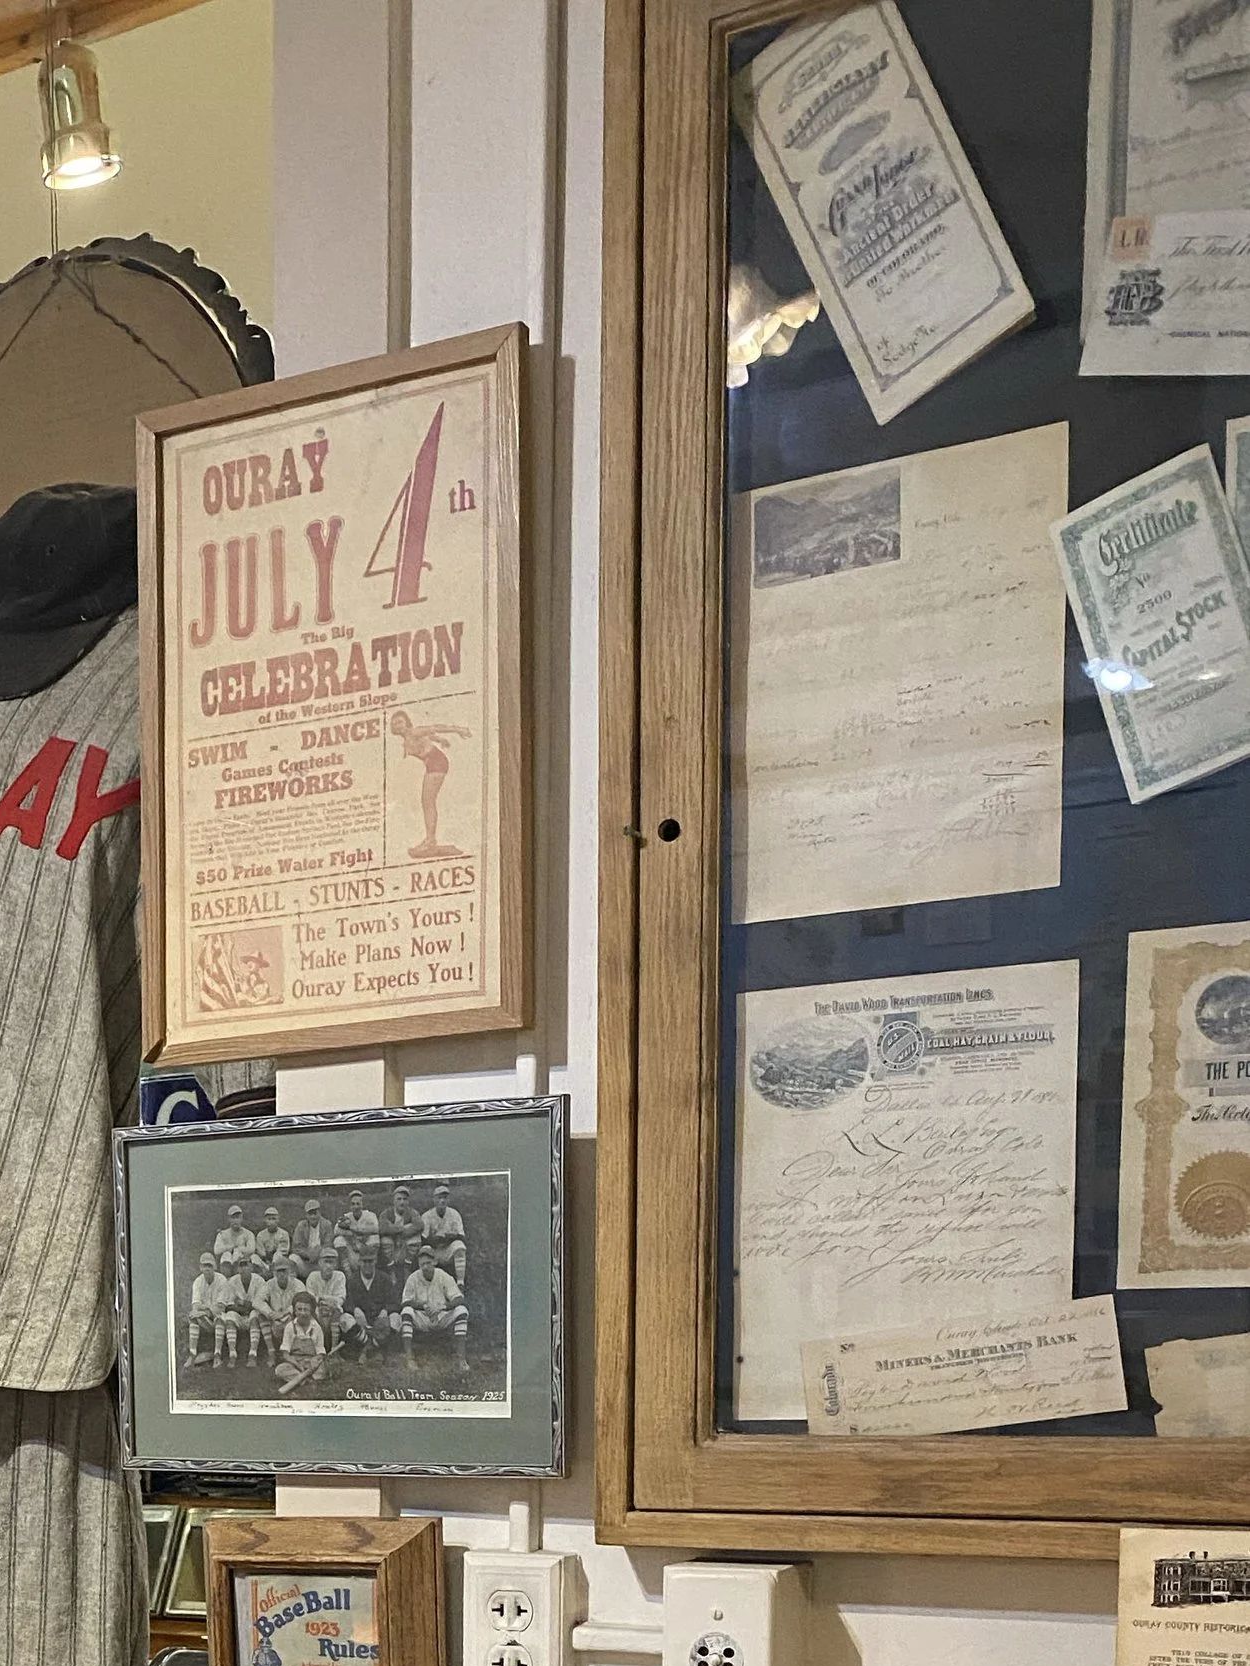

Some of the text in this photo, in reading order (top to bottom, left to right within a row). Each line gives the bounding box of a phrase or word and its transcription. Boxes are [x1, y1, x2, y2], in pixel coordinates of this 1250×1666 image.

[203, 439, 329, 515] OURAY
[189, 401, 476, 648] JULY 4 th
[301, 626, 354, 645] The Big
[200, 622, 464, 717] CELEBRATION
[259, 692, 398, 724] of the Western Slope
[188, 718, 380, 768] SWIM DANCE
[222, 753, 344, 782] Games Contests
[214, 770, 354, 810] FIREWORKS
[196, 849, 374, 885] $50 Prize Water Fight
[190, 866, 476, 922] BASEBALL STUNTS RACES
[292, 922, 326, 944] The
[336, 912, 400, 938] Town's
[409, 907, 462, 930] Yours
[300, 950, 347, 971] Make
[356, 942, 400, 965] Plans
[410, 936, 452, 958] Now
[292, 979, 346, 999] Ouray
[354, 970, 420, 994] Expects
[428, 963, 462, 984] You
[1206, 1062, 1228, 1080] THE
[382, 1388, 406, 1400] Ball
[481, 1391, 505, 1400] 1925
[305, 1622, 340, 1637] 1923
[318, 1638, 379, 1662] Rules
